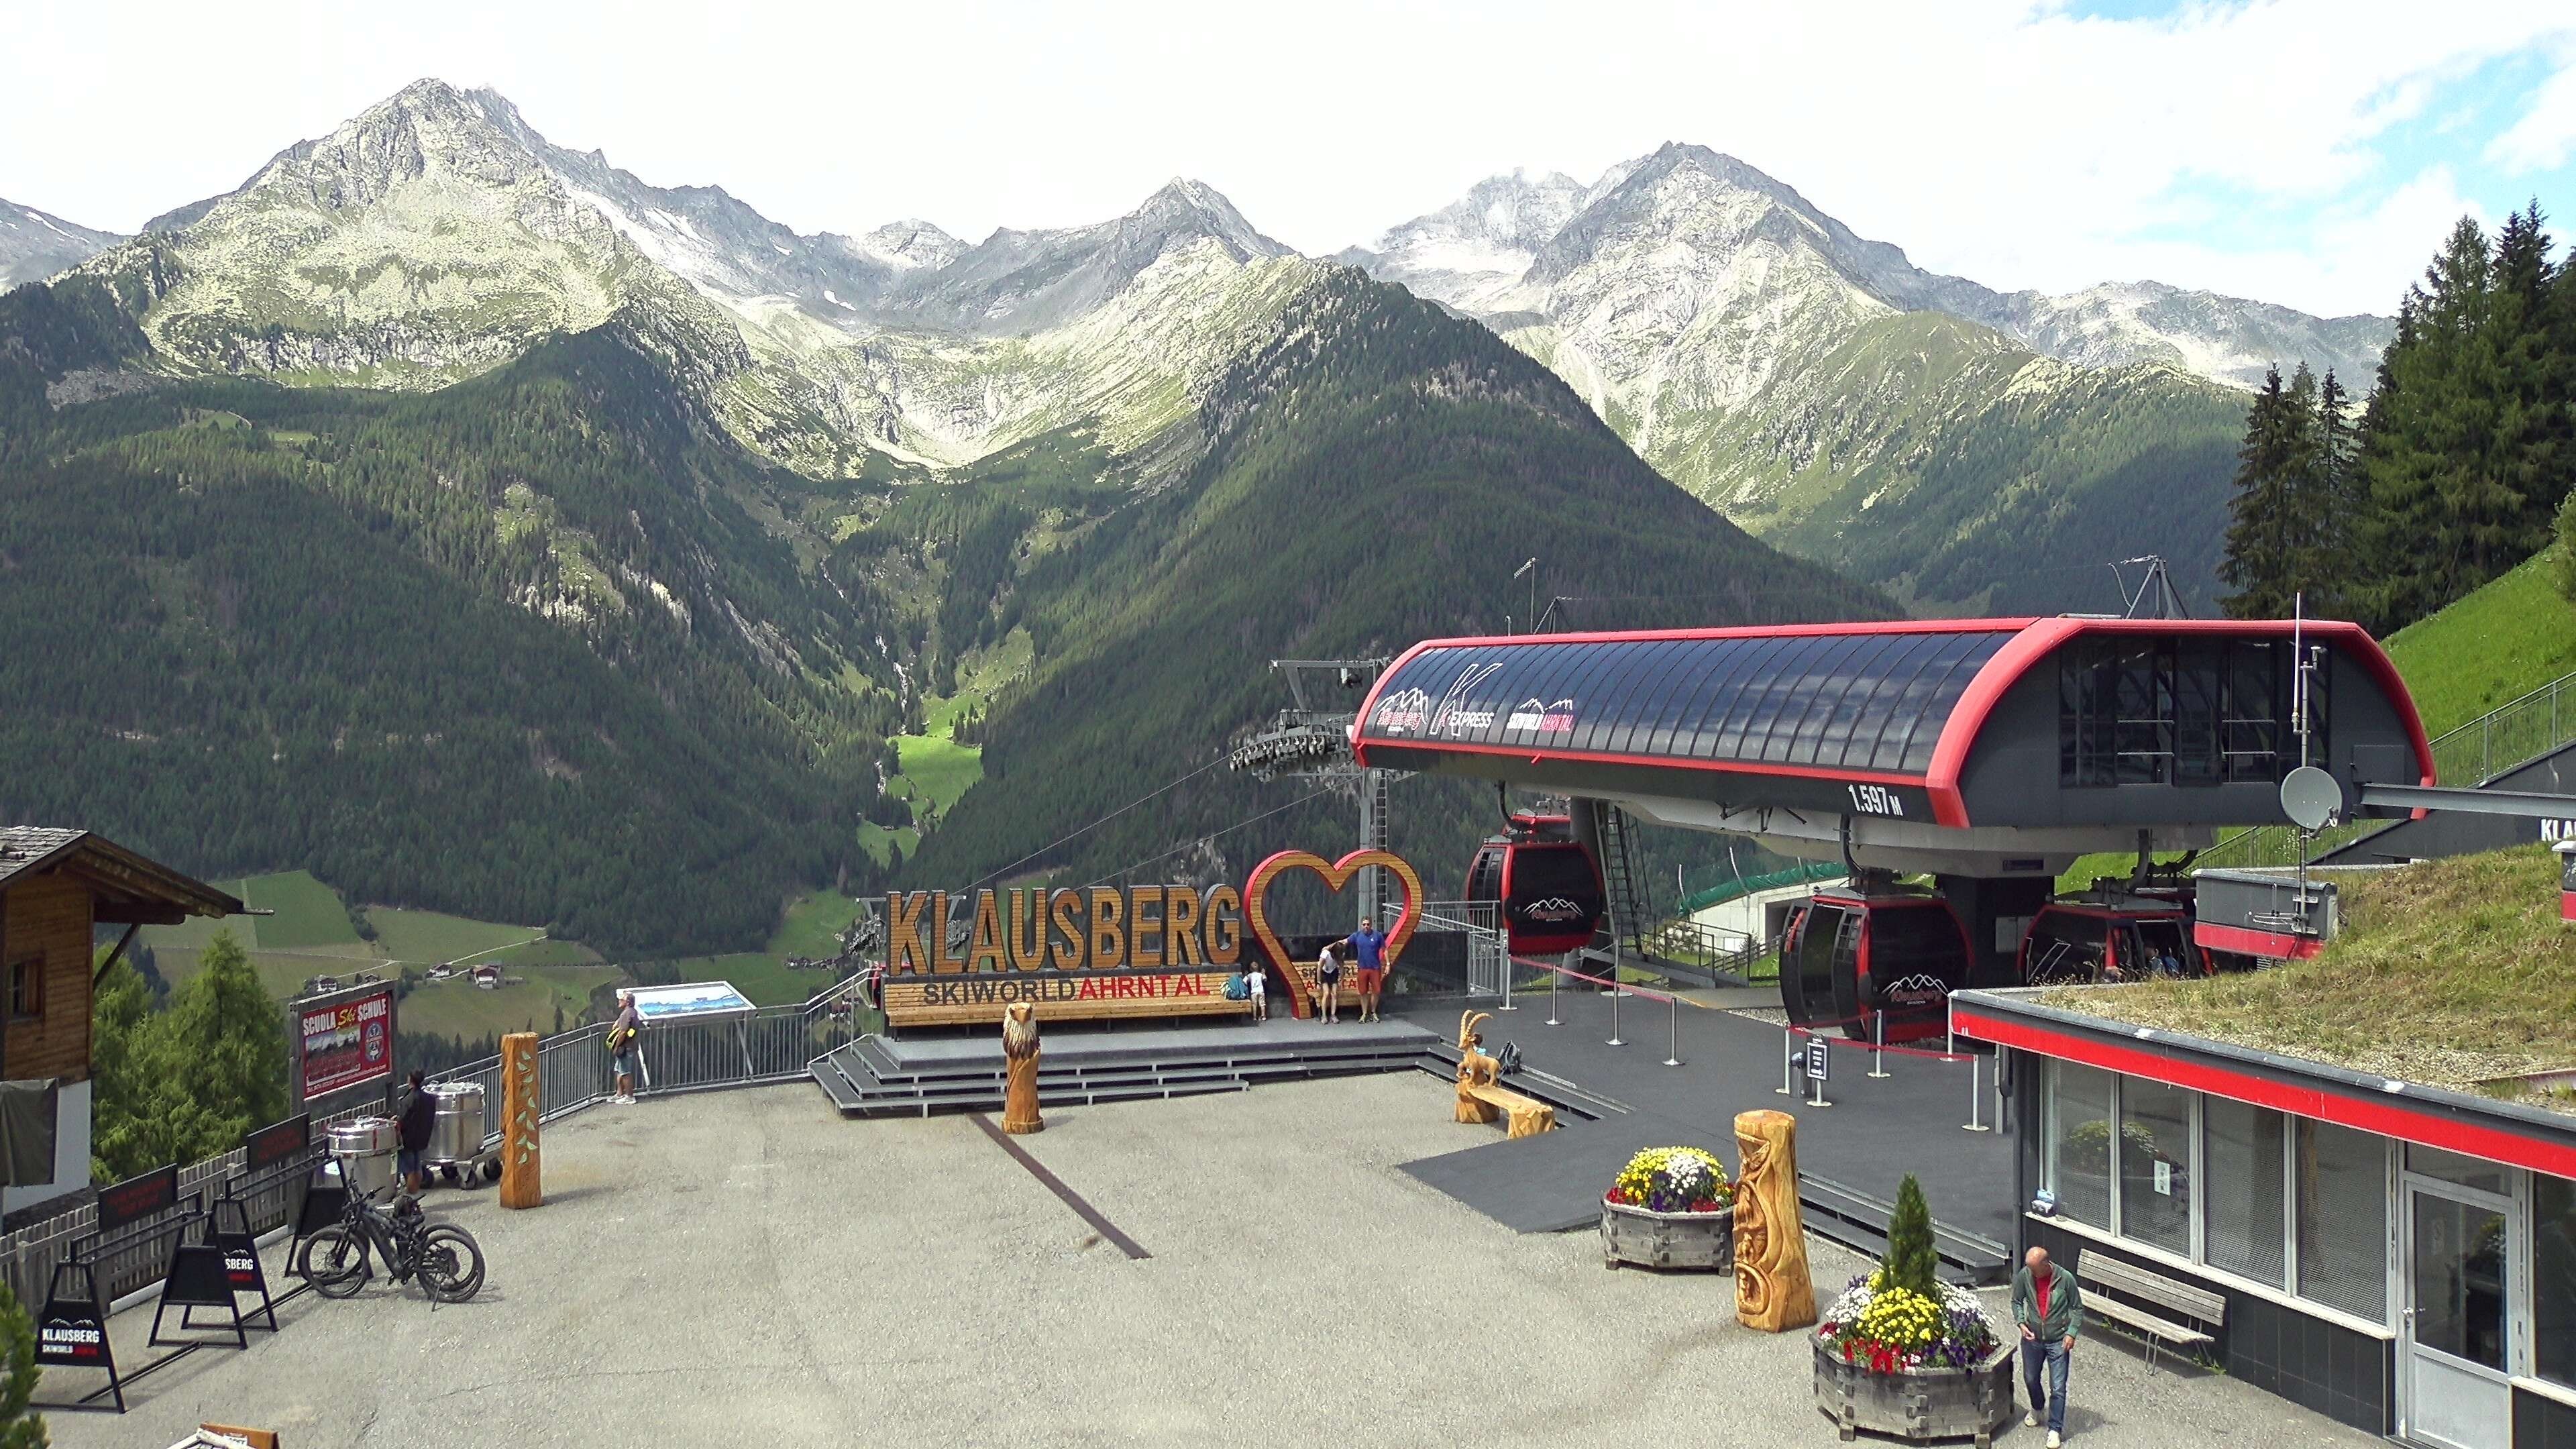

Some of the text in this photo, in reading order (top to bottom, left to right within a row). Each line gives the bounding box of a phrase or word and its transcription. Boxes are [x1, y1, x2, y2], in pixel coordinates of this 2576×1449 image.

[1848, 784, 1889, 814] 1.597
[2541, 819, 2576, 841] KLA
[887, 884, 1240, 977] KLAUSBERG
[303, 1011, 336, 1036] SCUOLA
[358, 998, 386, 1022] SCHULE
[42, 1328, 100, 1343] KLAUSBERG
